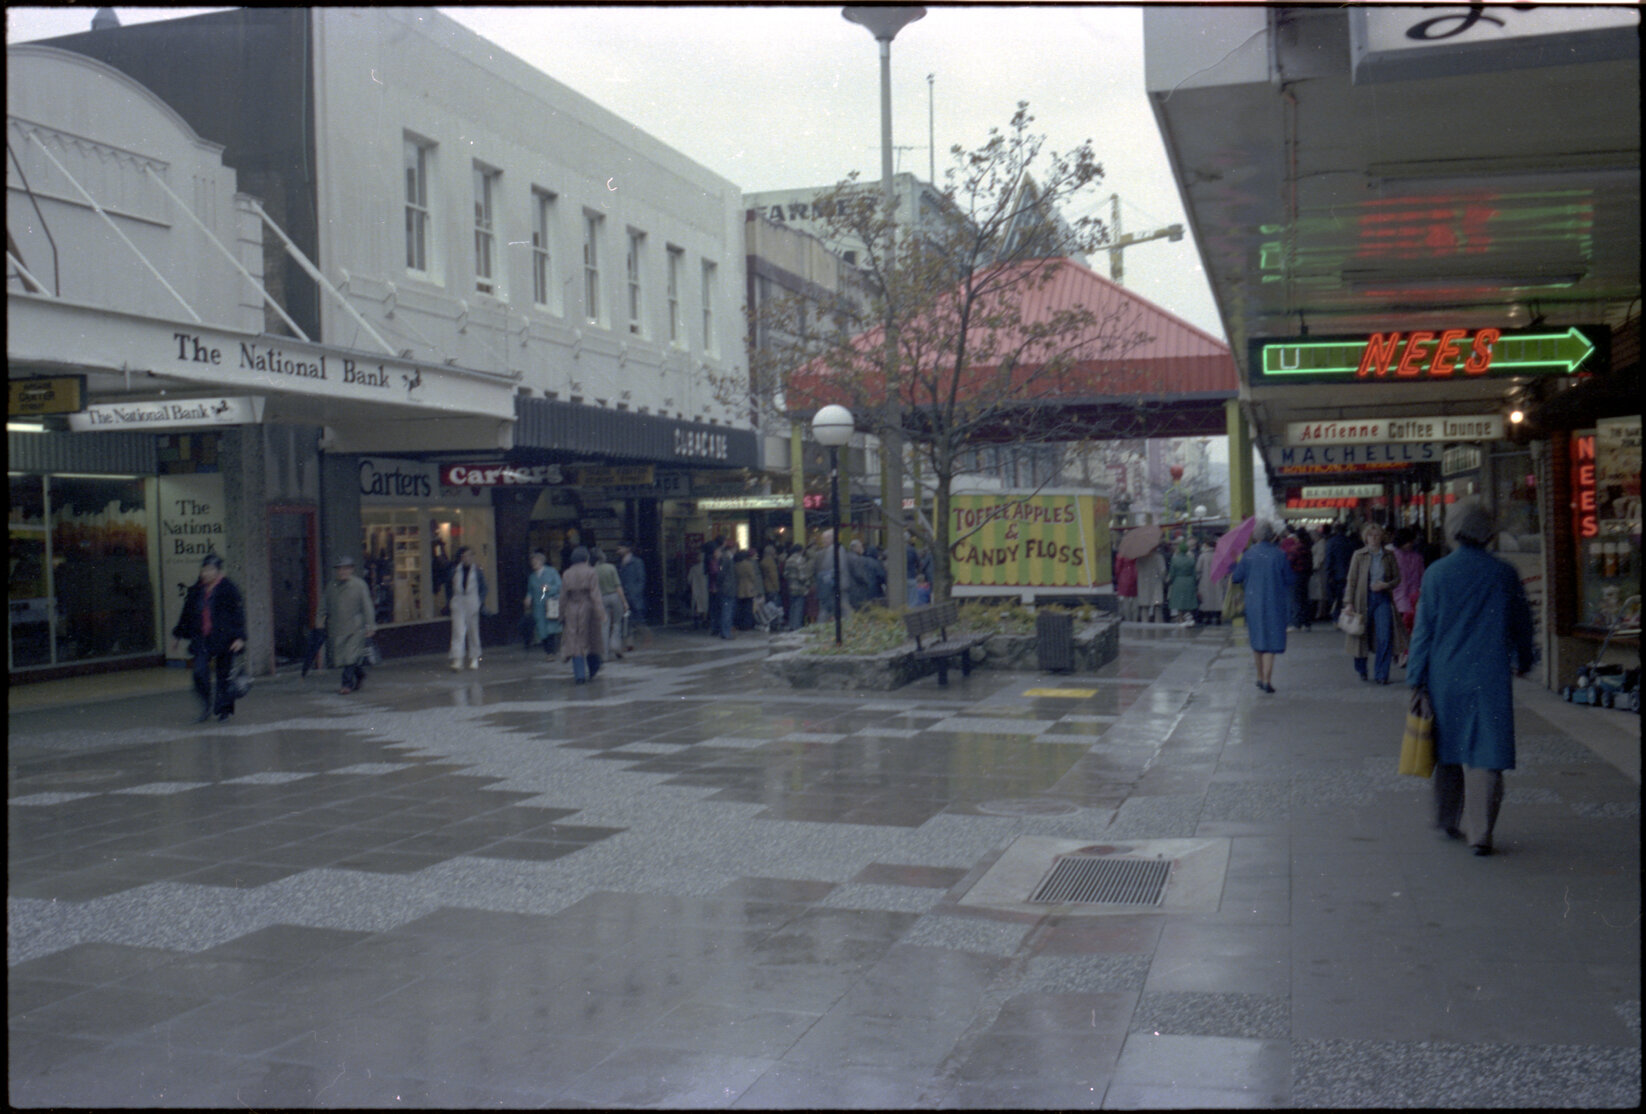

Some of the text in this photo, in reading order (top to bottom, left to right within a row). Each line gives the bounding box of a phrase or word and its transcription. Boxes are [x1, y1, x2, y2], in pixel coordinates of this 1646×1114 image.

[173, 332, 391, 389] The National Bank
[1356, 328, 1500, 378] NEES
[89, 402, 210, 425] The National Bank
[1301, 420, 1492, 441] Adrienne Coffee Lounge
[1281, 442, 1435, 464] MACHELL'S
[358, 459, 432, 497] Carters
[449, 463, 564, 485] Carters
[1577, 436, 1598, 537] NEES
[175, 499, 211, 516] The
[952, 501, 1077, 532] TOFFEE APPLES
[1005, 523, 1020, 540] &
[174, 537, 217, 555] Bank
[952, 538, 1085, 566] CANDY FLOSS
